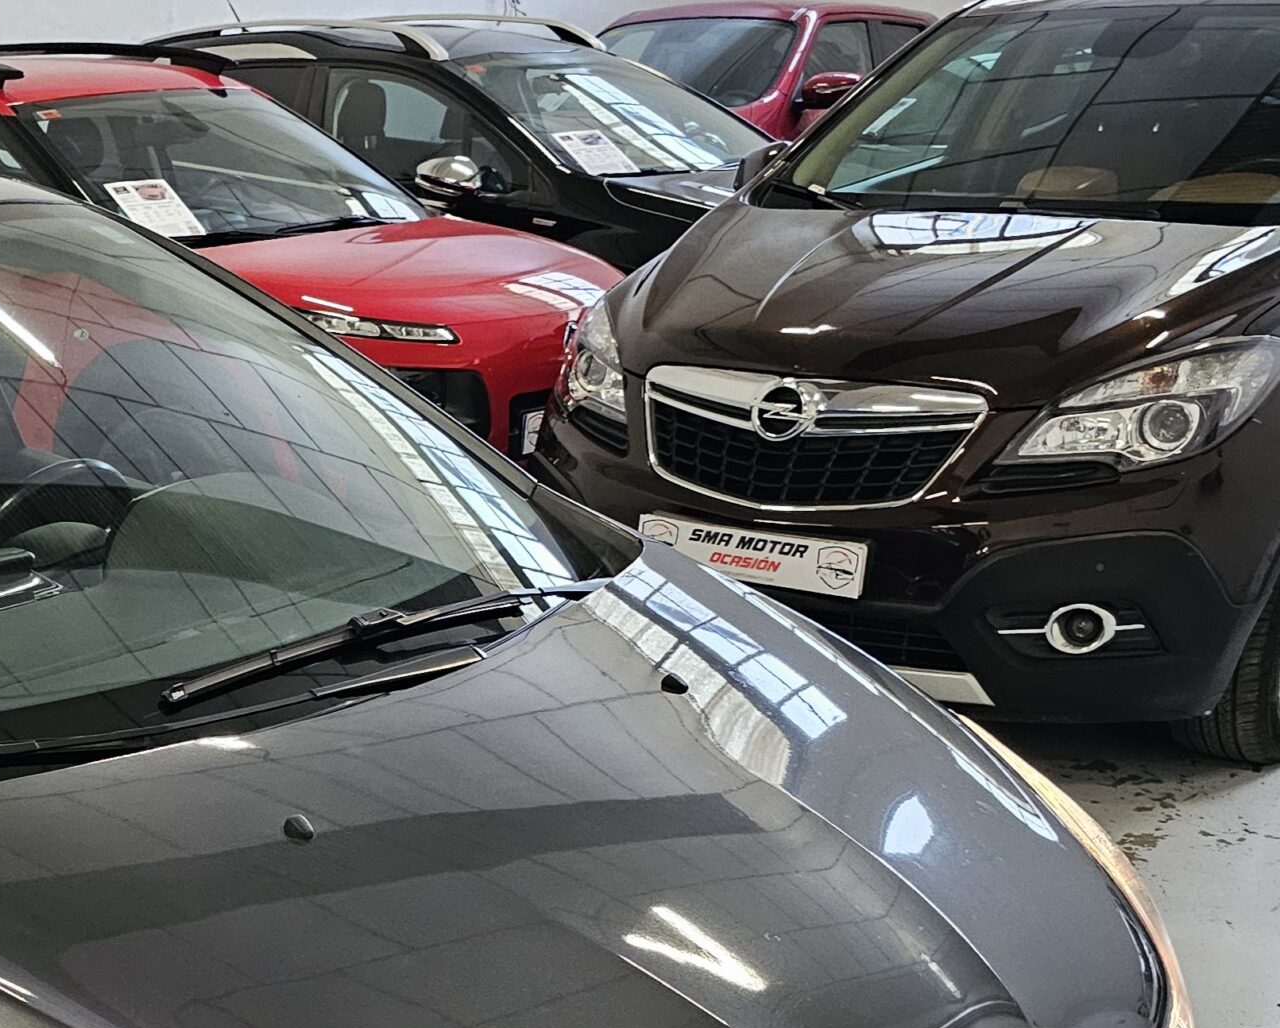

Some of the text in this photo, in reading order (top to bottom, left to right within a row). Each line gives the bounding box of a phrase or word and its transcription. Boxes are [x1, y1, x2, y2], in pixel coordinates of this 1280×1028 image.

[688, 528, 809, 559] SMA MOTOR
[709, 551, 782, 573] OCASIÓN
